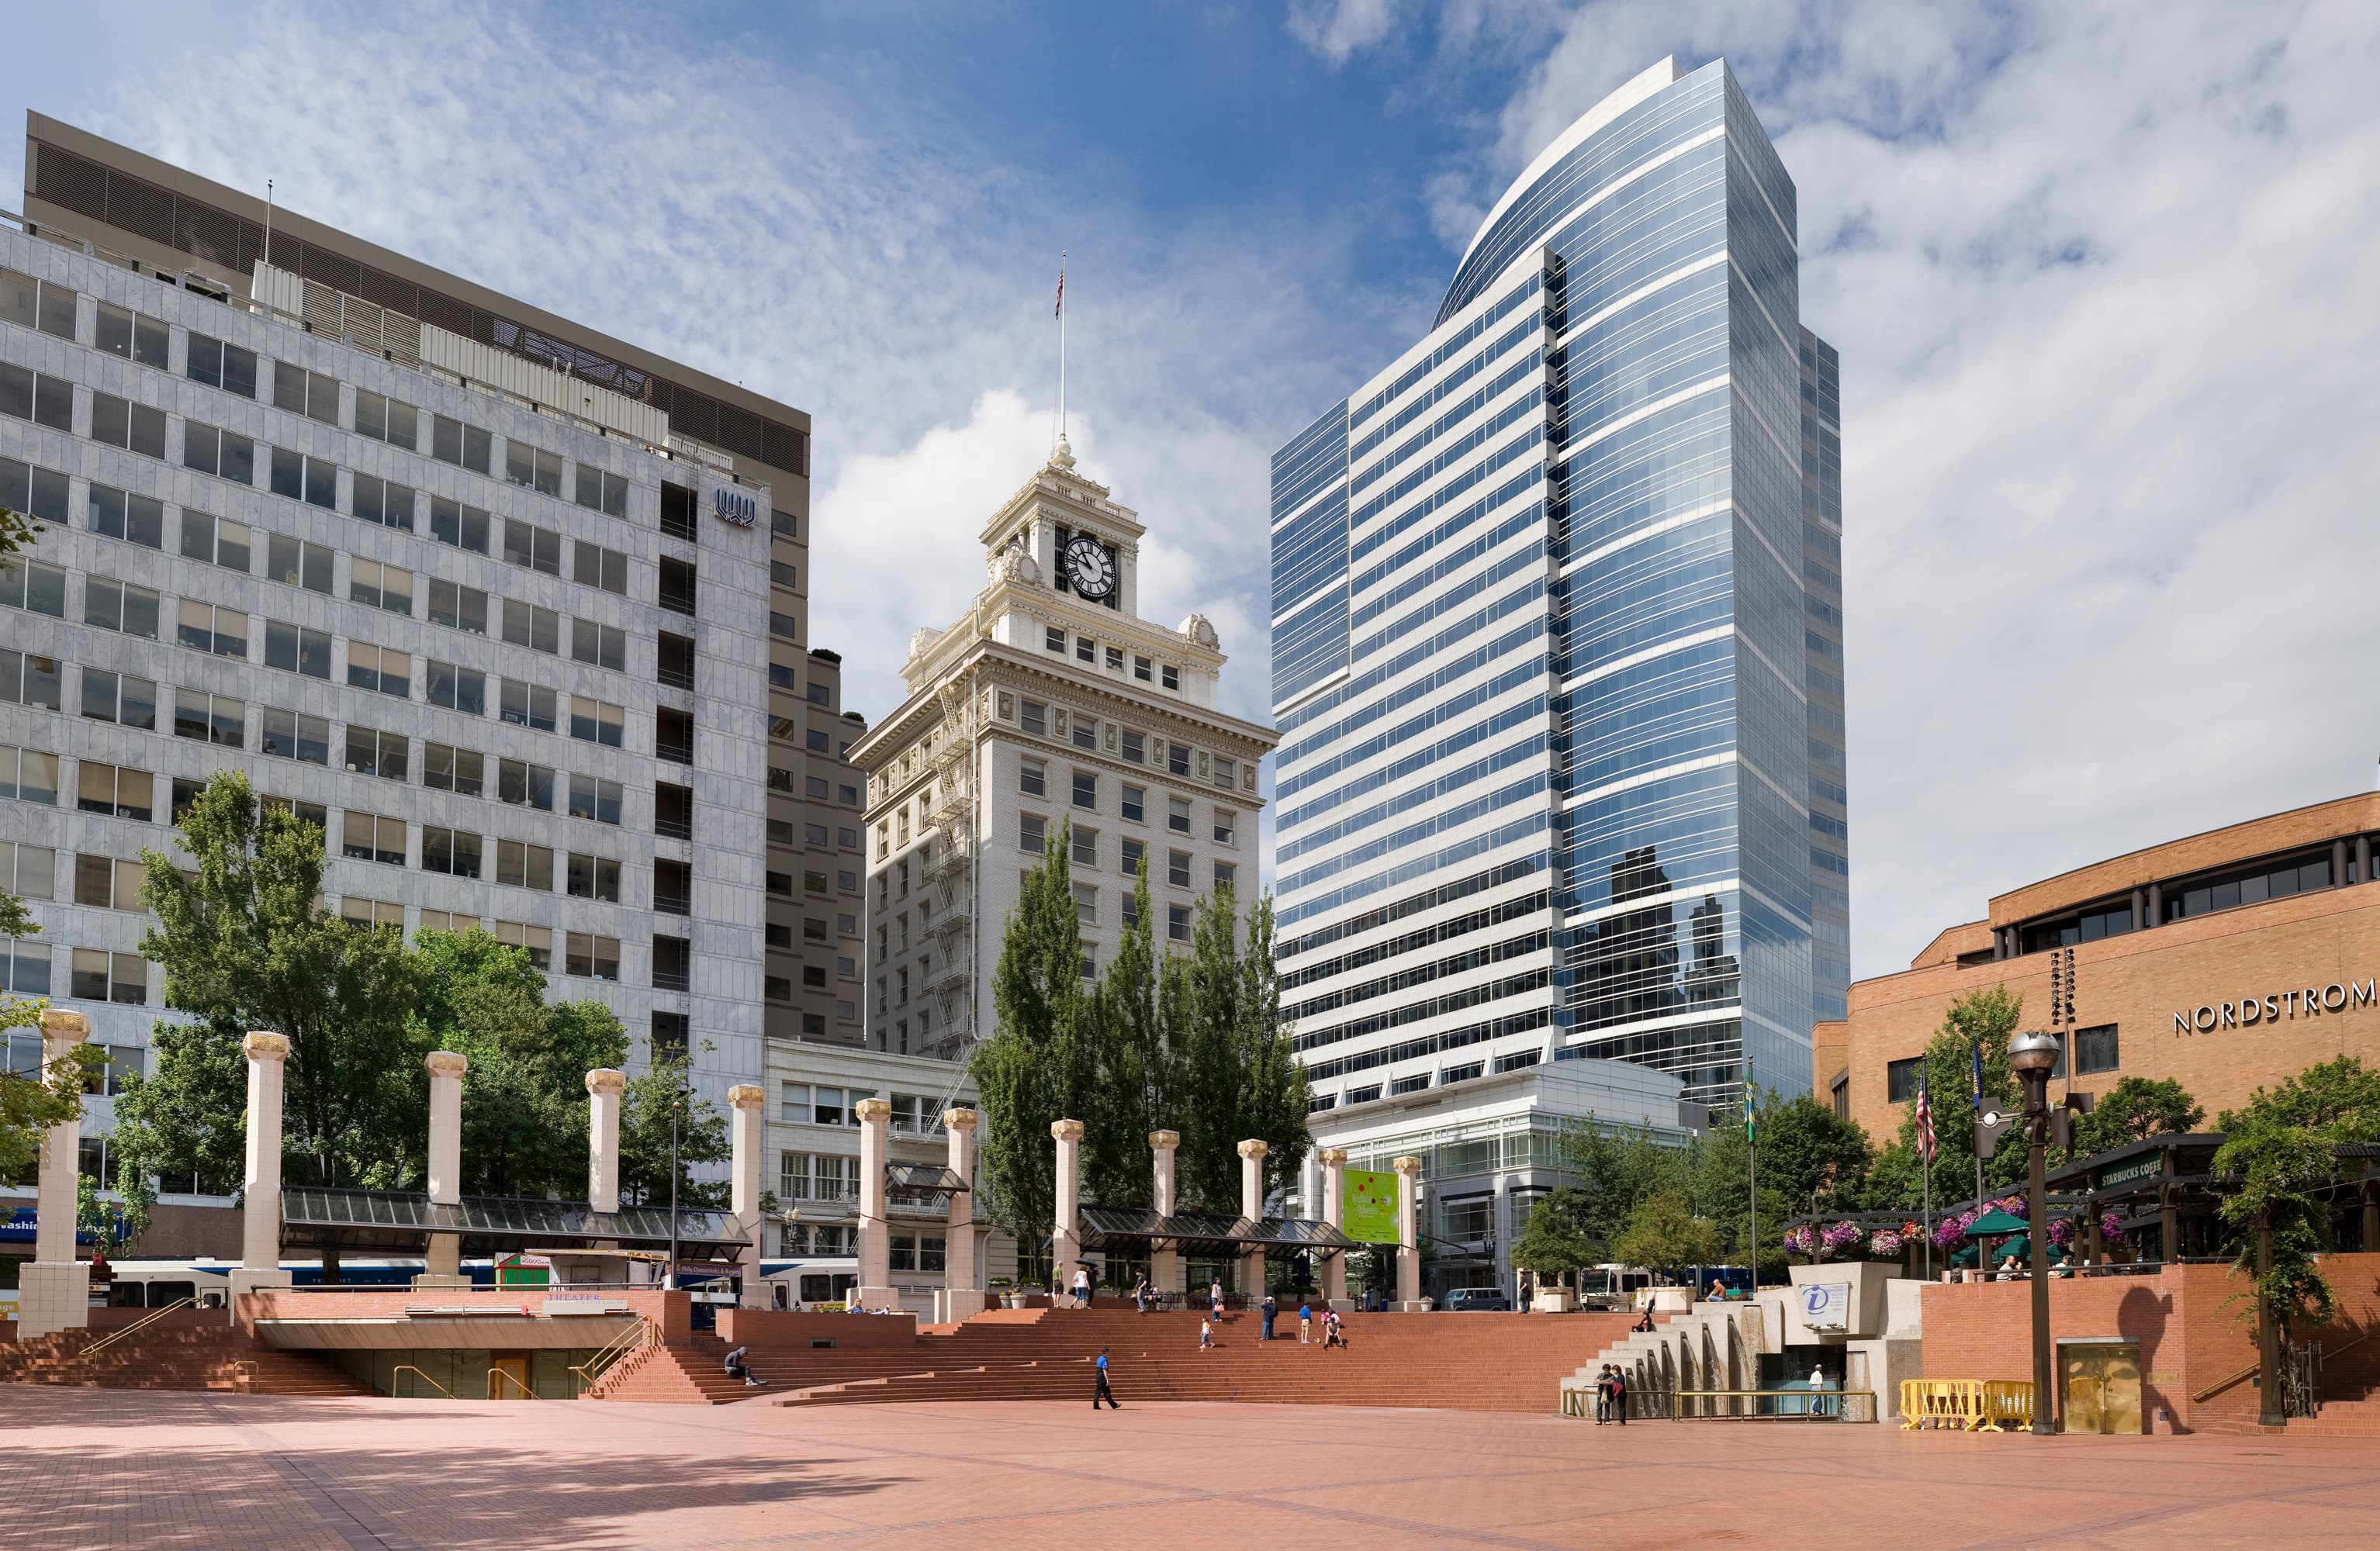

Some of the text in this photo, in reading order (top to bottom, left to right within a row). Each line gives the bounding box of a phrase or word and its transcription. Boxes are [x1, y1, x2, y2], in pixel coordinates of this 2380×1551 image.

[2174, 977, 2376, 1032] NORDSTROM
[2102, 1159, 2162, 1187] STARBUCKS COFFE
